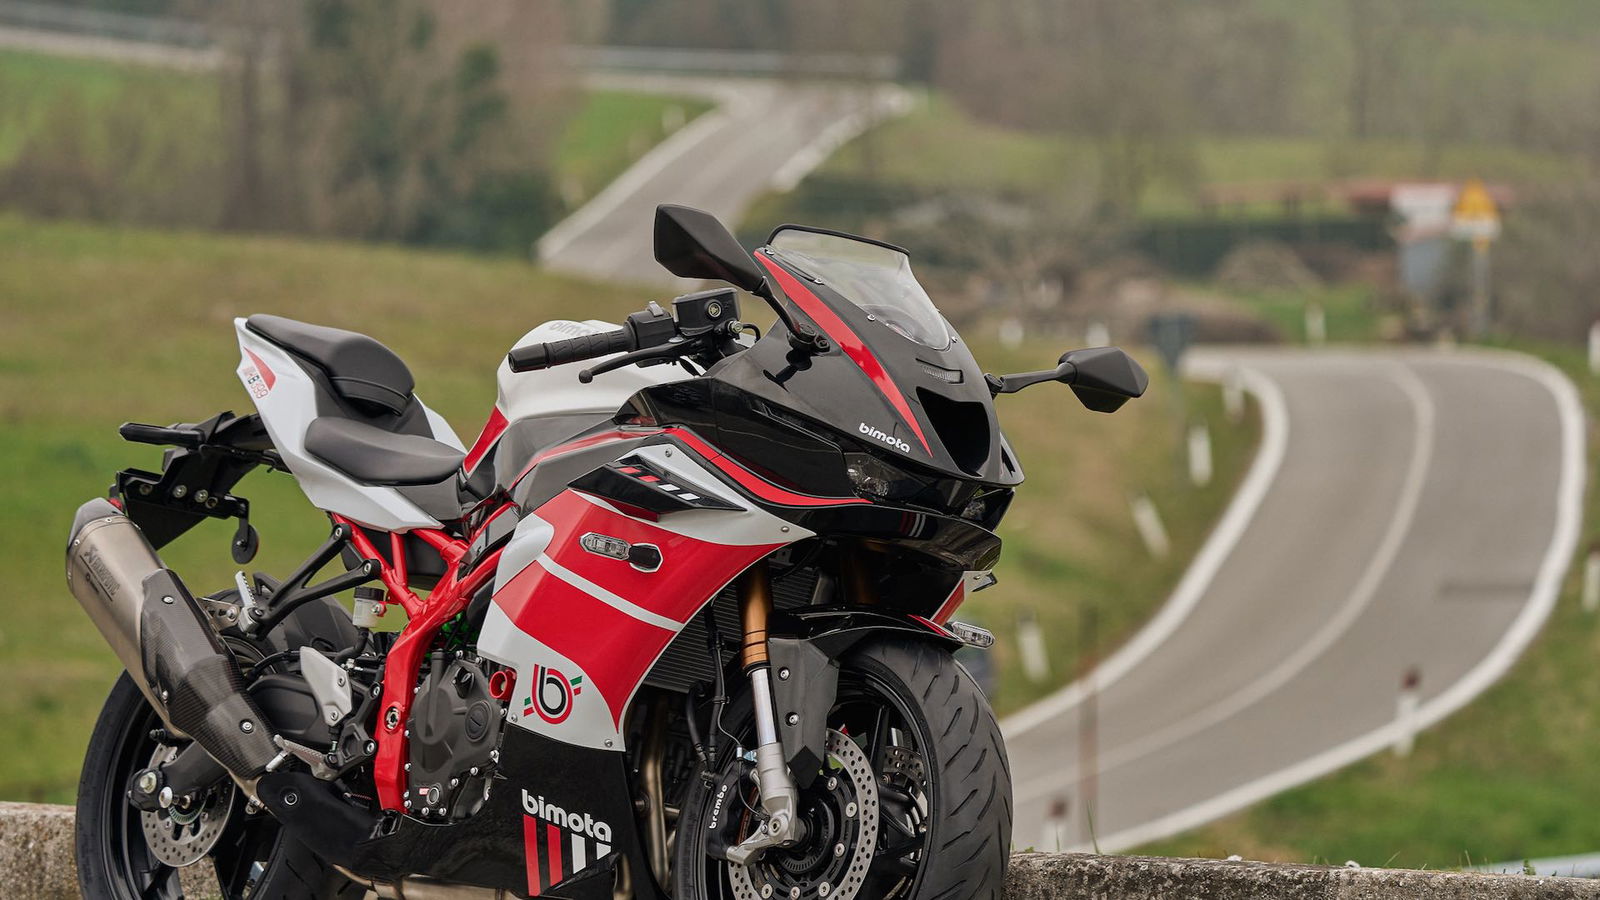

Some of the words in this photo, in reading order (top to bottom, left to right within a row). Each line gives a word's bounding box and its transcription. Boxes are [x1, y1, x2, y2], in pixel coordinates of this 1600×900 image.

[858, 422, 911, 453] bimota
[521, 788, 612, 843] bimota
[708, 784, 728, 829] brembo
